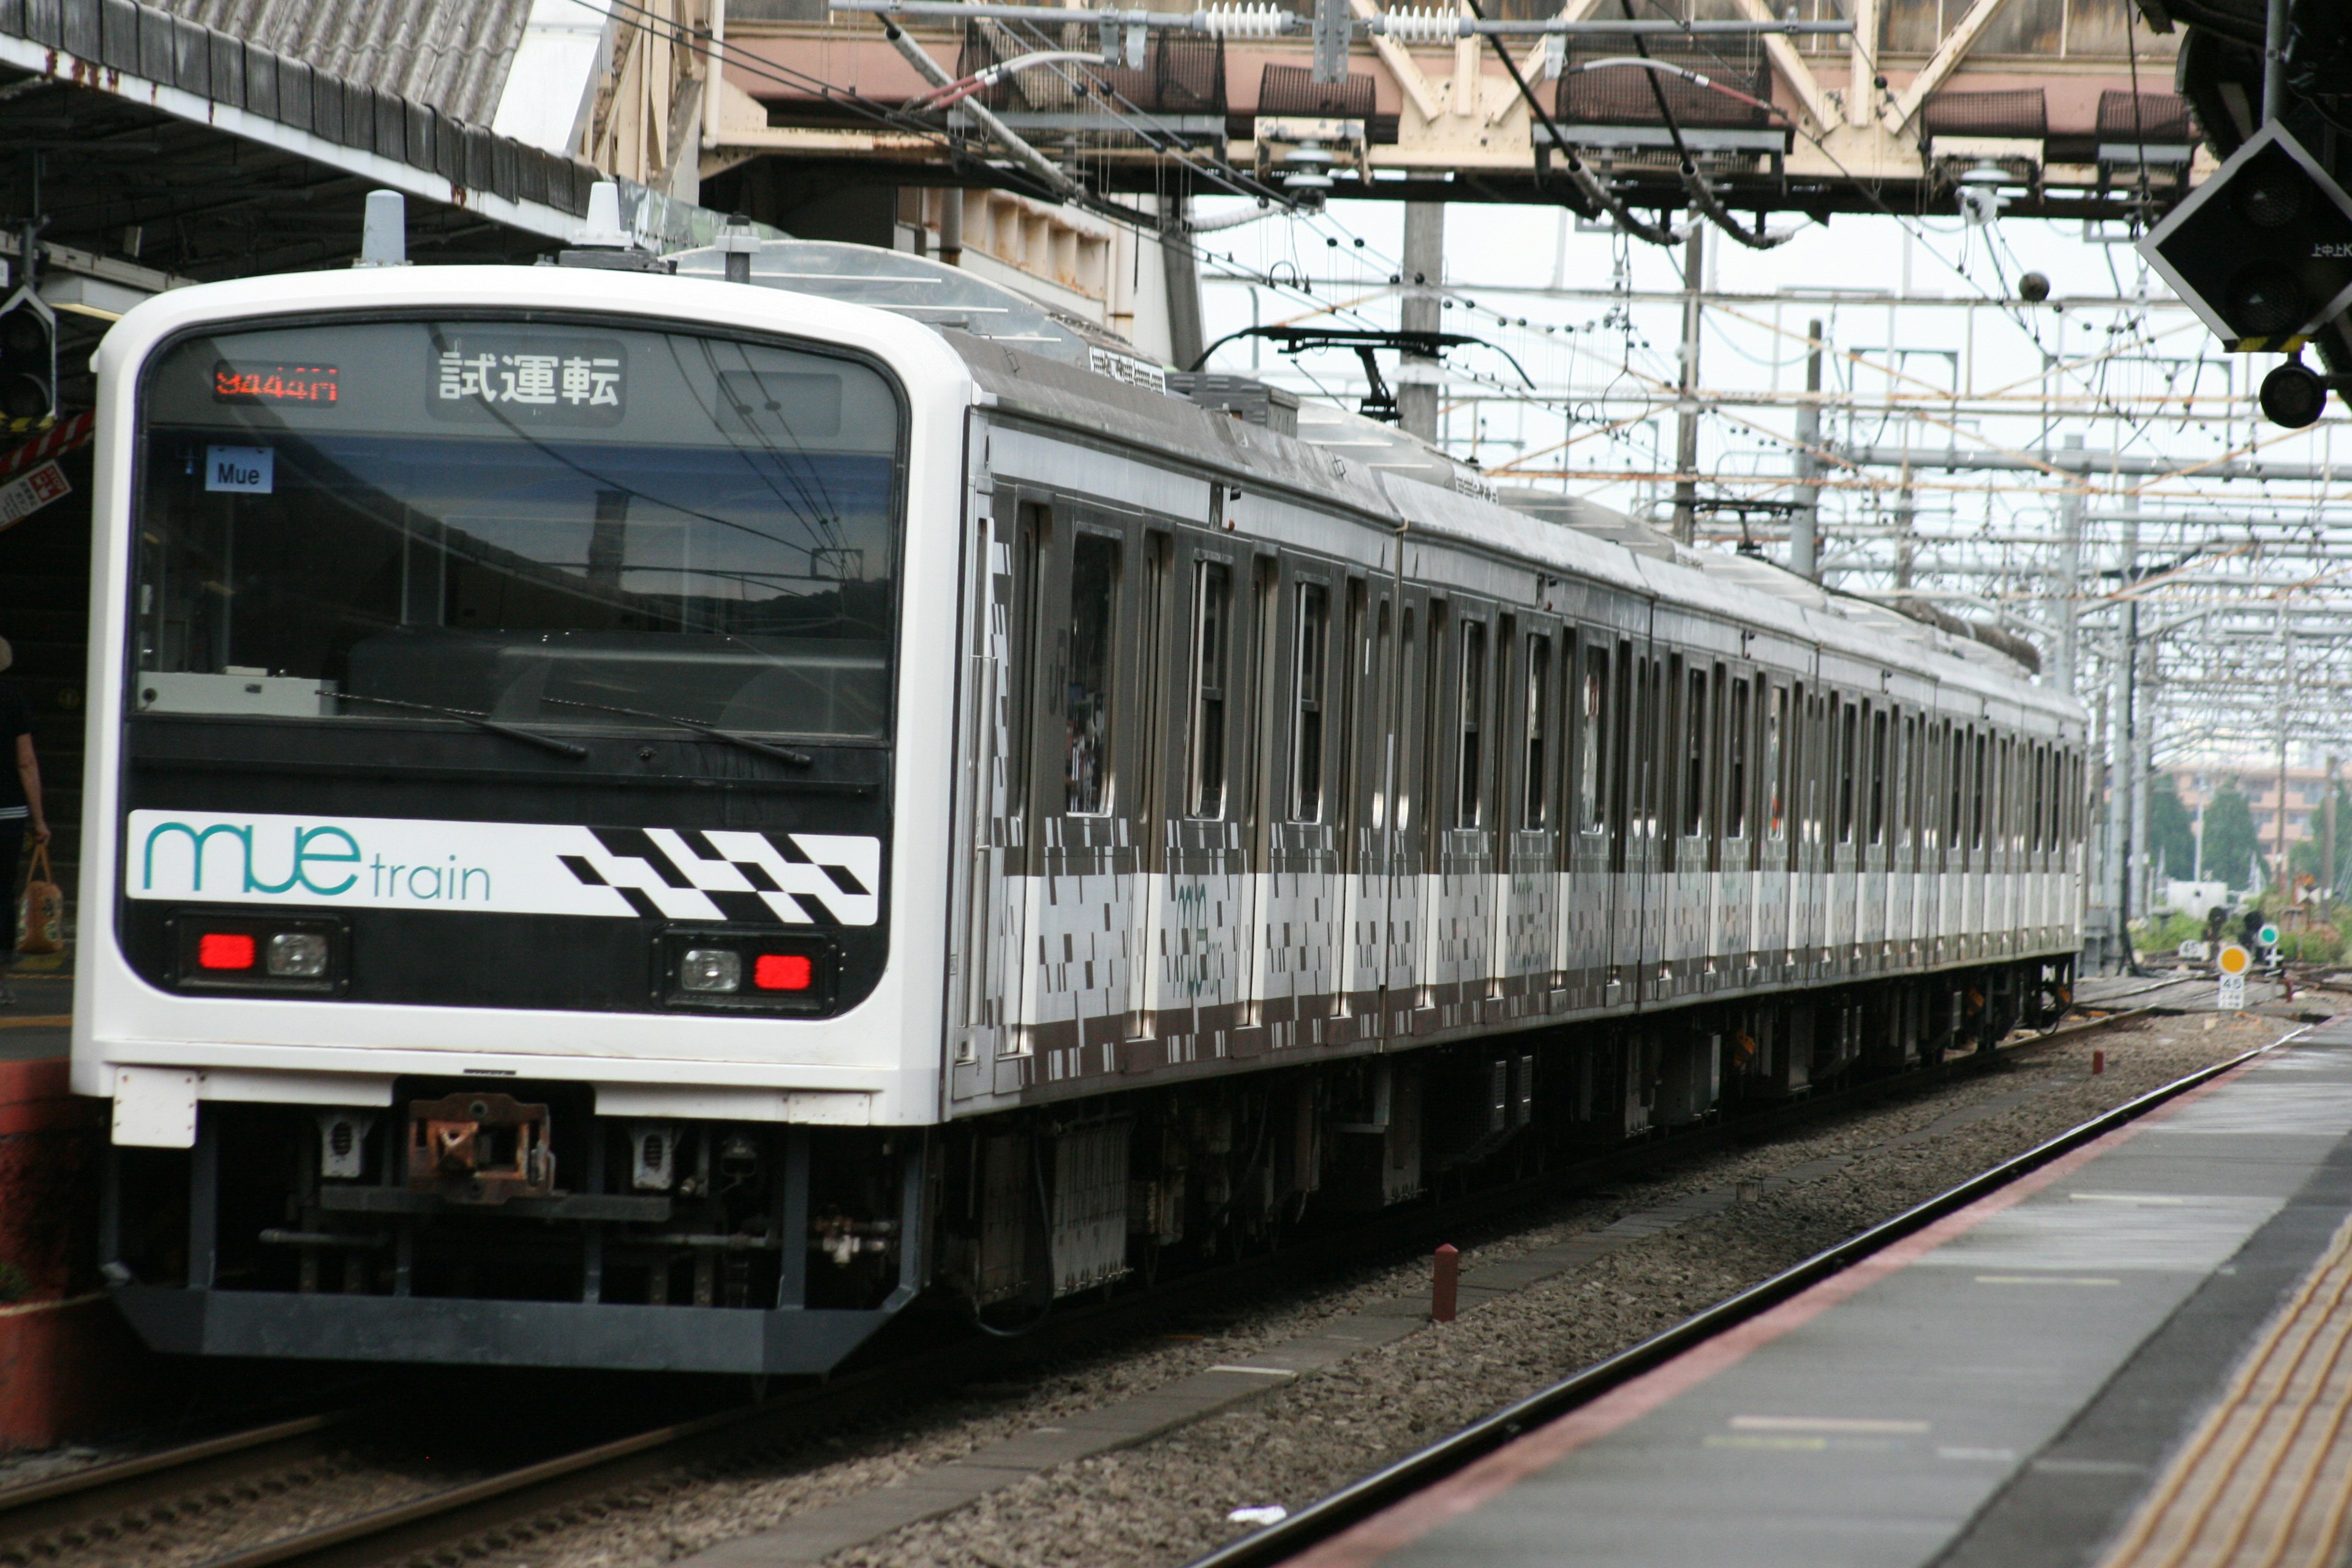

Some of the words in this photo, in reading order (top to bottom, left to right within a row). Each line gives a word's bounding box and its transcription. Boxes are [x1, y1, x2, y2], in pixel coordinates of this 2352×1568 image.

[439, 352, 620, 405] 試運転
[217, 462, 260, 484] Mue
[143, 821, 361, 896] mue
[370, 853, 491, 901] train
